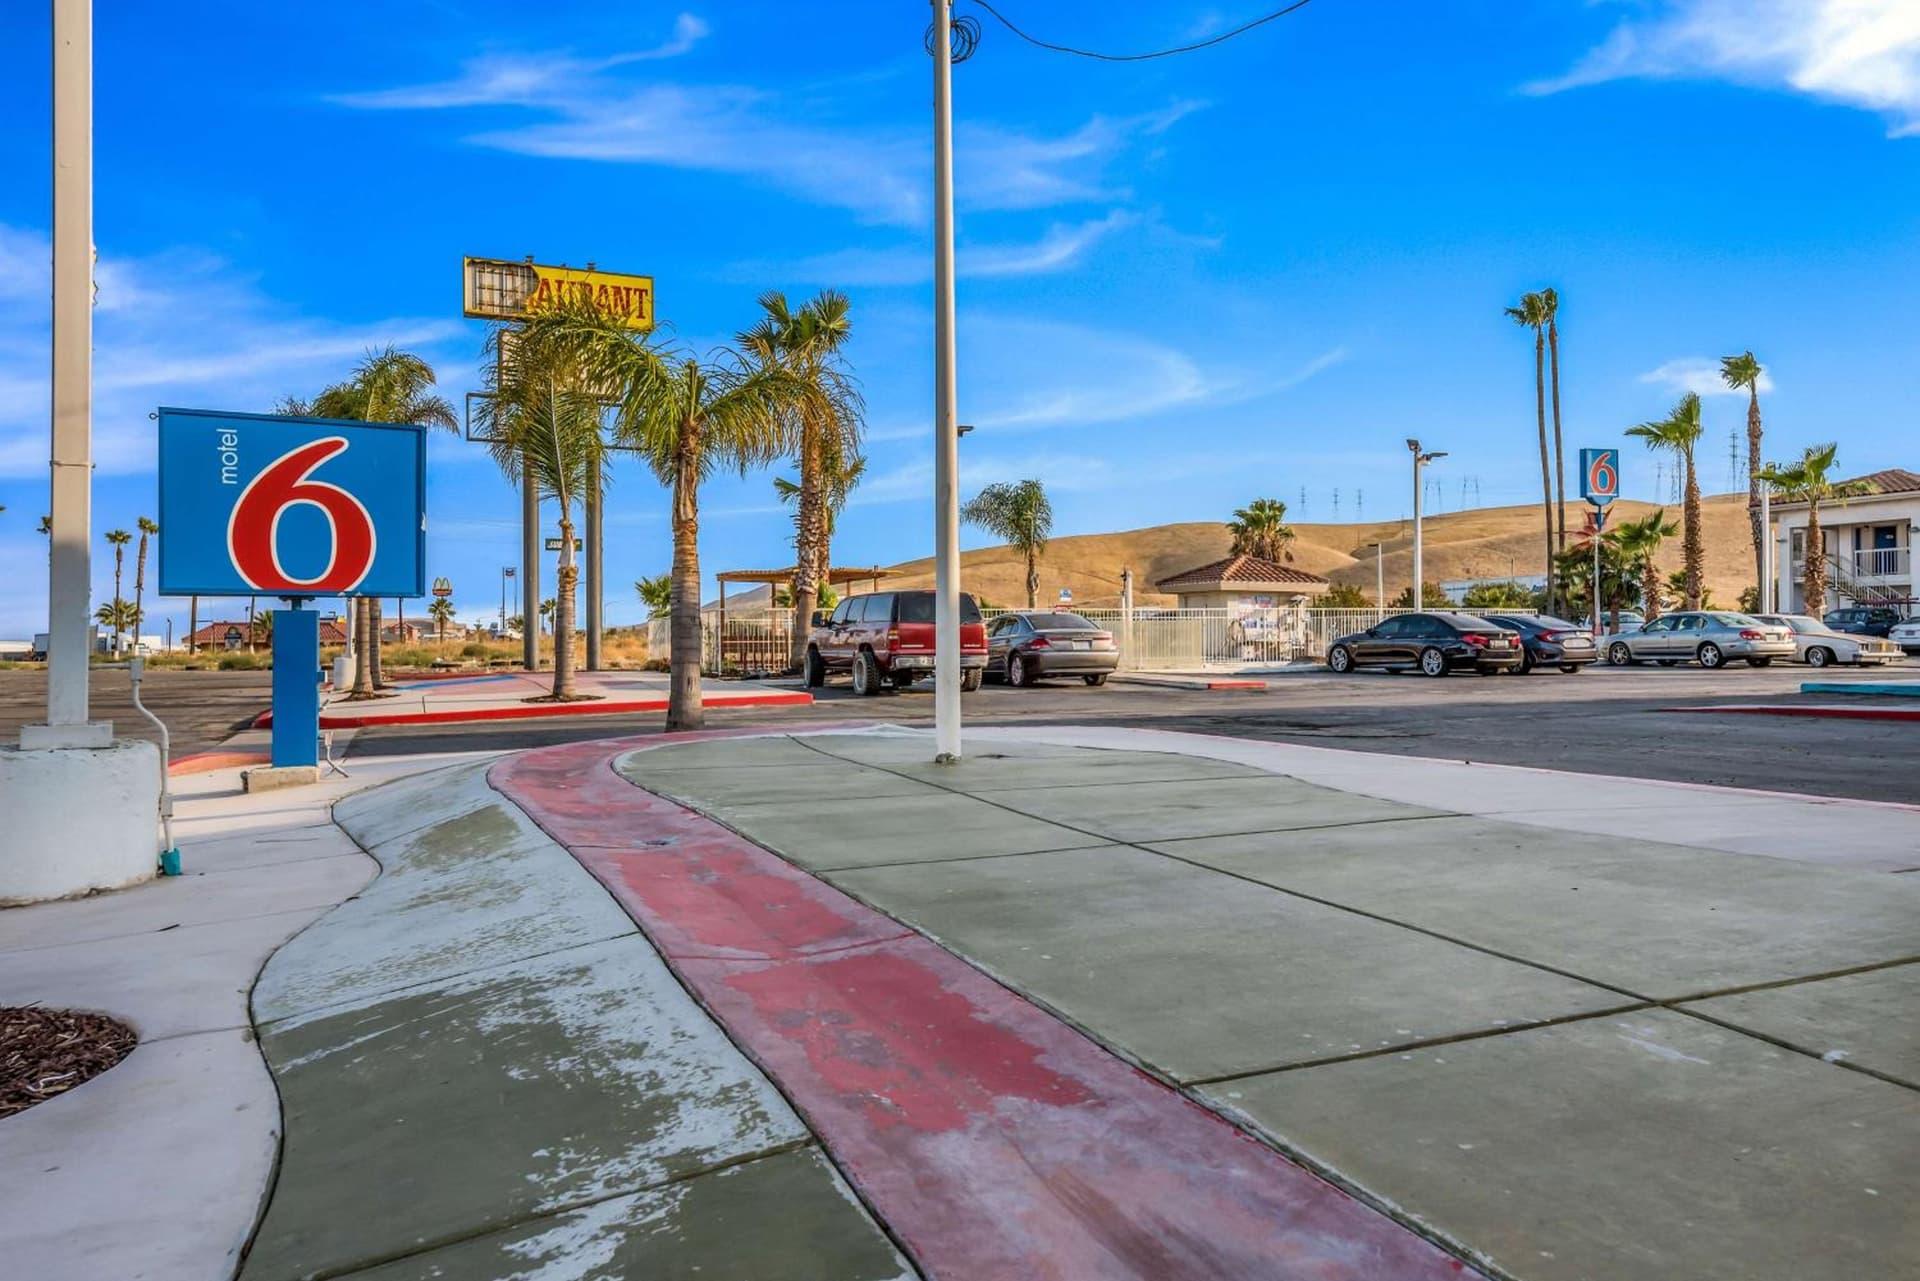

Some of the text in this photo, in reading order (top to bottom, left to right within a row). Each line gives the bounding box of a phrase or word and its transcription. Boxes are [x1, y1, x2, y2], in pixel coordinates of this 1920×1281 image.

[216, 428, 238, 484] motel
[1589, 451, 1618, 494] 6
[227, 436, 377, 590] 6
